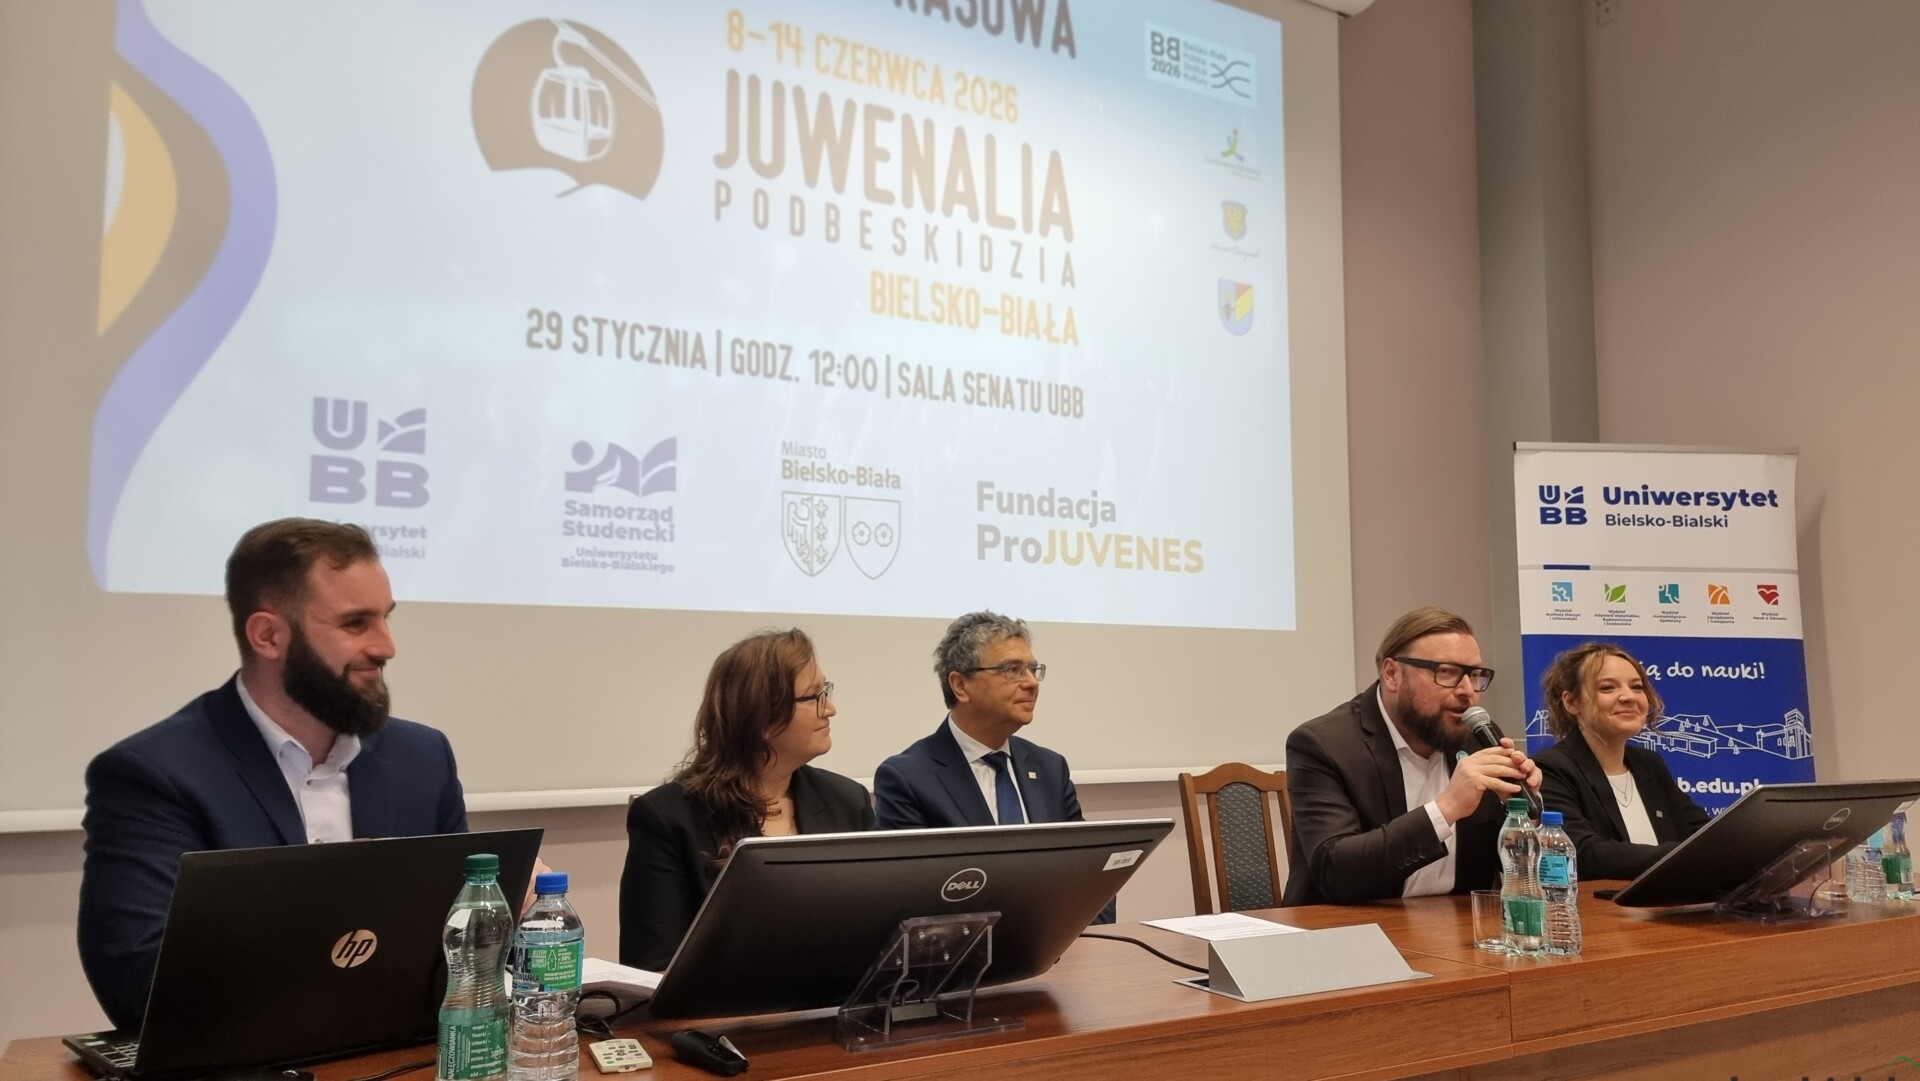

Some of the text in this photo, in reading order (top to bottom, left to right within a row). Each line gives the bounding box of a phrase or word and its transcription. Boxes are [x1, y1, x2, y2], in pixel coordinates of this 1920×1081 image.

[815, 33, 947, 106] CZERWCA
[954, 71, 1020, 125] 2026
[1150, 57, 1181, 79] 2026
[713, 68, 1074, 243] JUWENALIA
[715, 179, 1075, 289] PODBESKIDZIA
[870, 270, 1079, 346] BIELSKO-BIAŁA
[526, 308, 563, 351] 29
[572, 315, 707, 371] STYCZNIA
[730, 337, 800, 383] GODZ.
[808, 348, 878, 392] 12:00
[898, 361, 956, 403] SALA
[963, 370, 1042, 414] SENATU
[1048, 383, 1084, 419] UBB
[781, 440, 827, 459] Miasto
[781, 460, 901, 490] Bielsko-Biała
[976, 480, 1117, 528] Fundacja
[1602, 484, 1779, 511] Uniwersytet
[564, 500, 673, 523] Samorząd
[1605, 514, 1729, 528] Bielsko-Bialski
[370, 525, 427, 540] rsytet
[562, 520, 675, 542] Studencki
[576, 546, 658, 561] Uniwersytetu
[976, 524, 1205, 574] ProJUVENES
[561, 556, 674, 574] Bielsko-Bialskiego
[1667, 661, 1694, 678] do
[1701, 662, 1766, 679] nauki!
[947, 880, 980, 891] DELL
